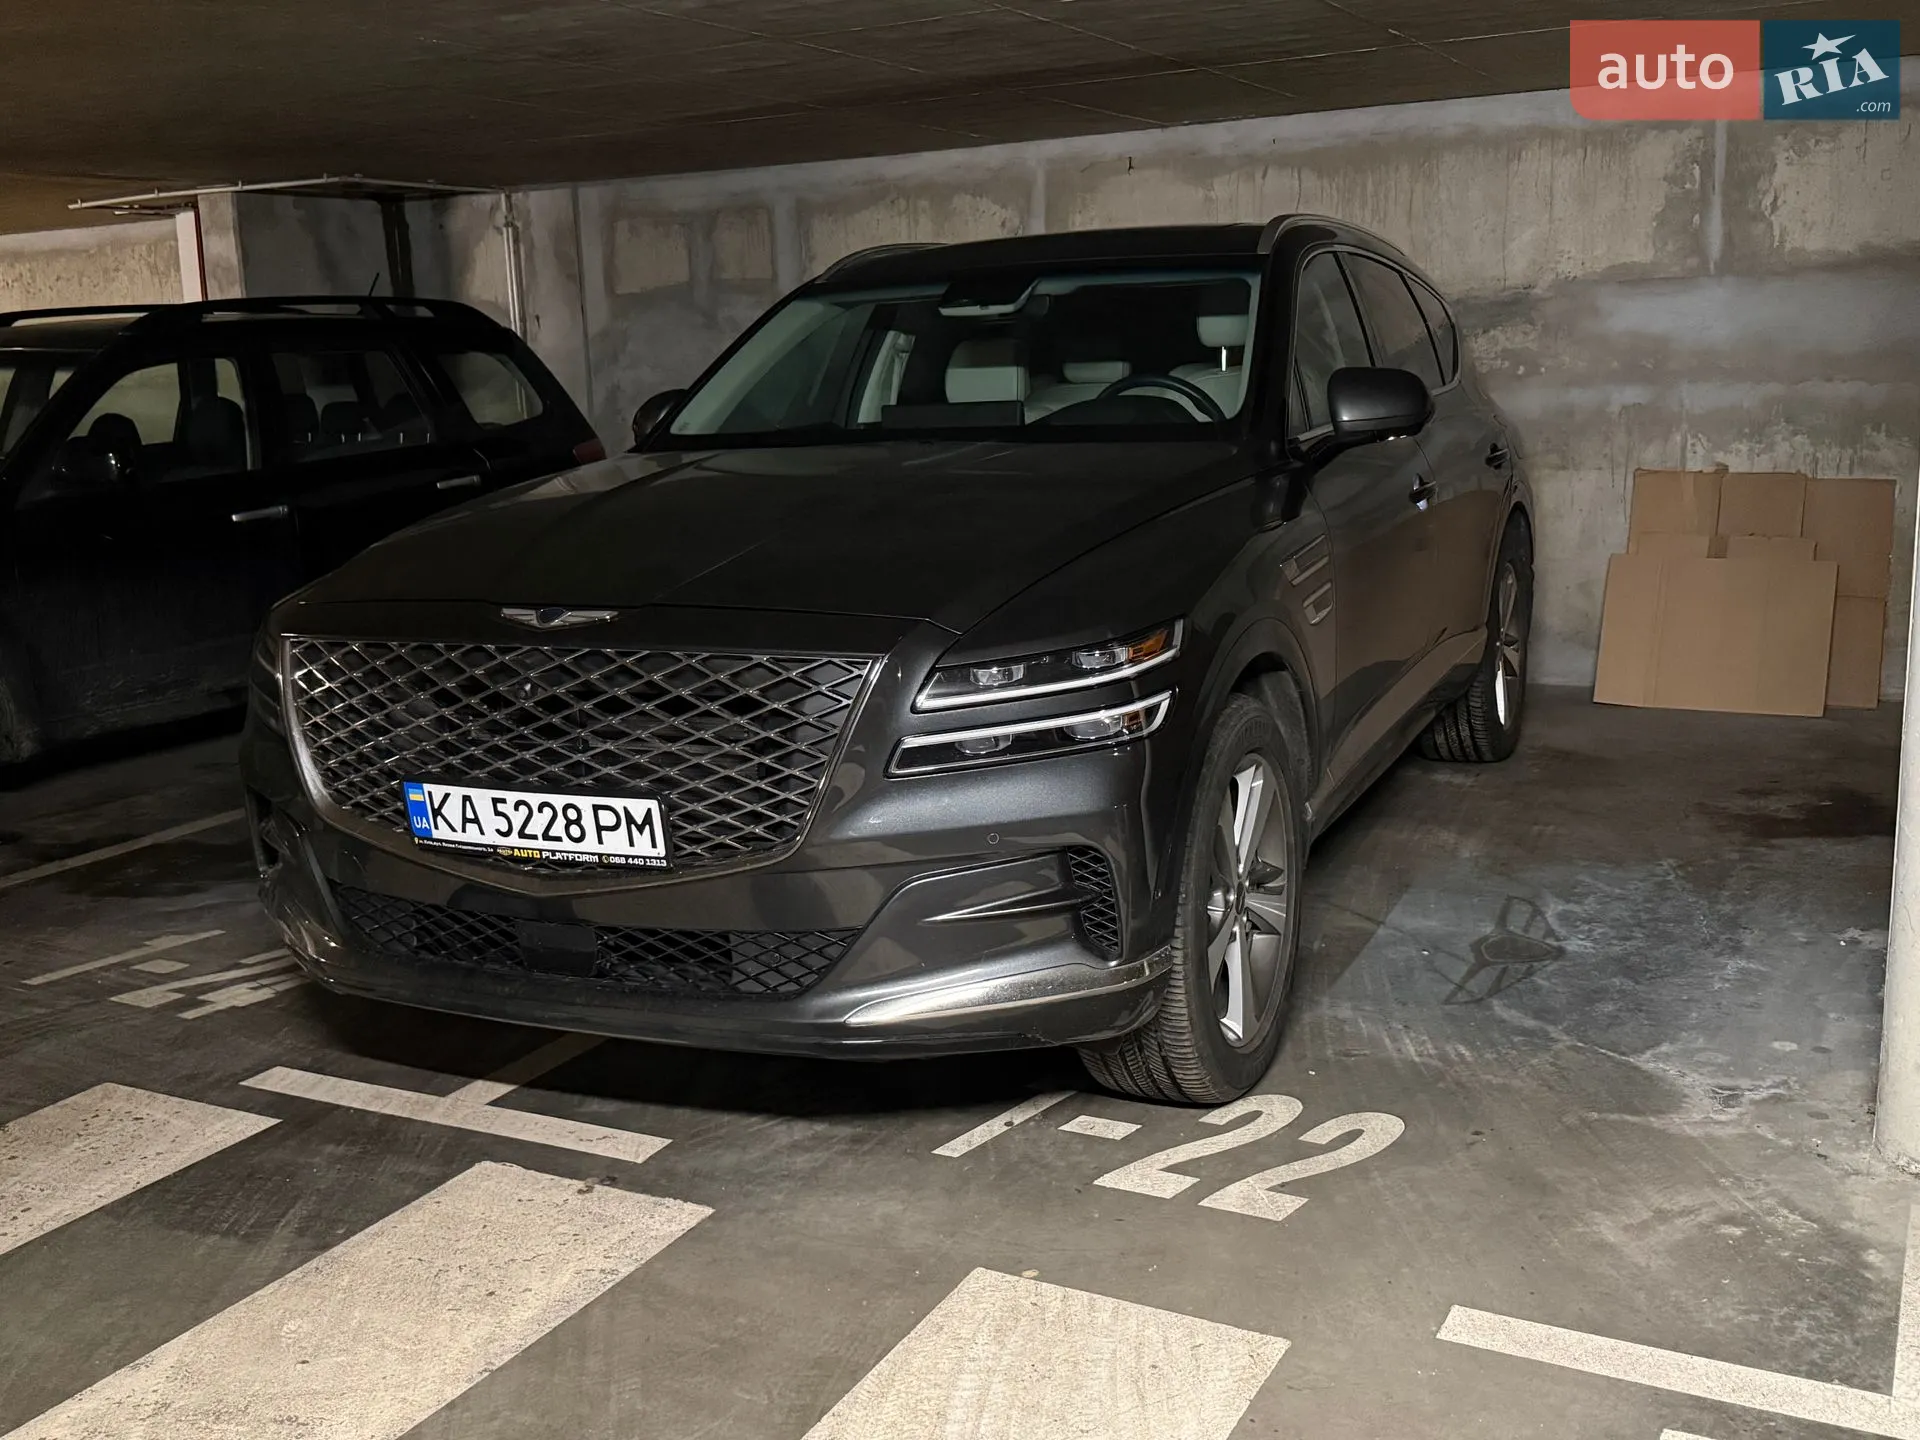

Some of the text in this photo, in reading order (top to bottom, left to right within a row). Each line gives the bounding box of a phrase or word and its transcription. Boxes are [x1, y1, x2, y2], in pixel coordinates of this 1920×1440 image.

[413, 815, 430, 830] UA
[427, 790, 658, 850] KA 5228 PM
[513, 848, 541, 859] AUTO
[542, 850, 599, 863] PLATFORM
[627, 857, 645, 866] 440
[645, 858, 667, 867] 1313
